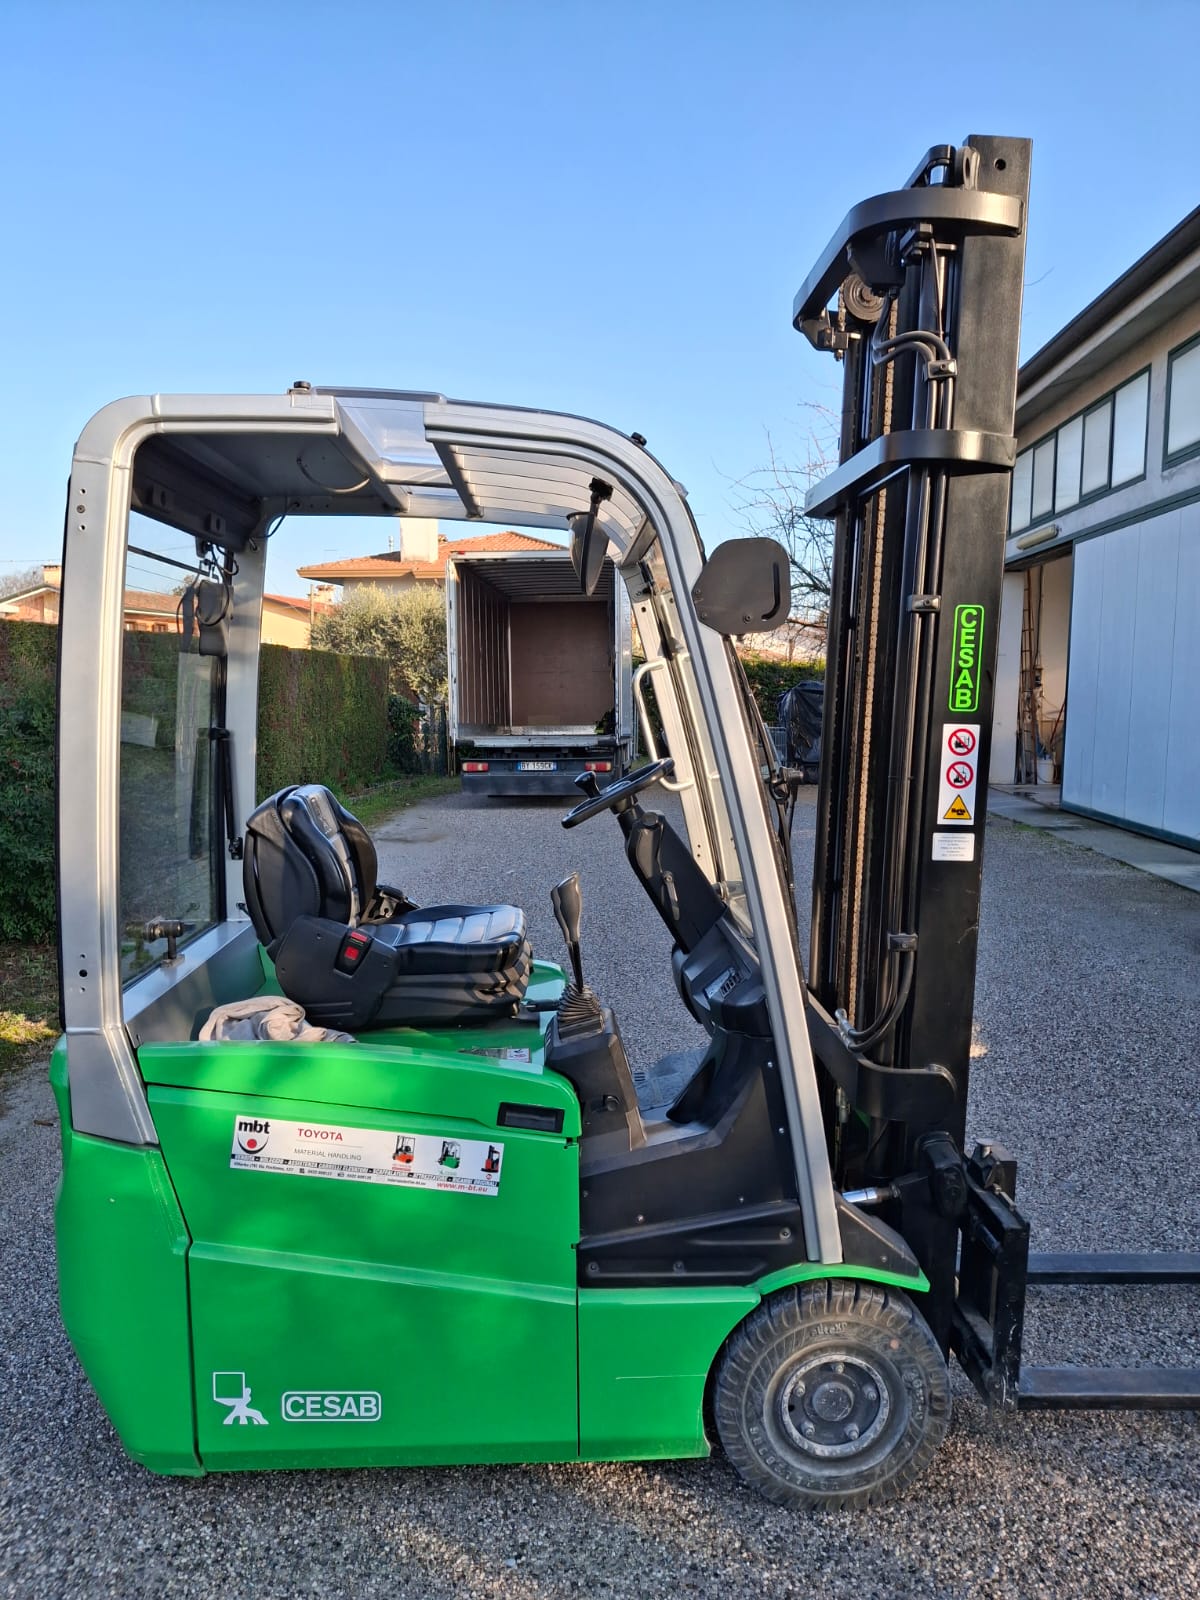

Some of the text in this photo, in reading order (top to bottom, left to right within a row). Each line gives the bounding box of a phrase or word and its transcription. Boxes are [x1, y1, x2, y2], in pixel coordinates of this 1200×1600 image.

[955, 608, 978, 708] CESAB
[238, 1120, 270, 1134] mbt
[297, 1128, 343, 1141] TOYOTA
[294, 1148, 362, 1161] MATERIAL HANDLING
[437, 1182, 488, 1192] www.m-bt.eu
[285, 1396, 378, 1417] CESAB
